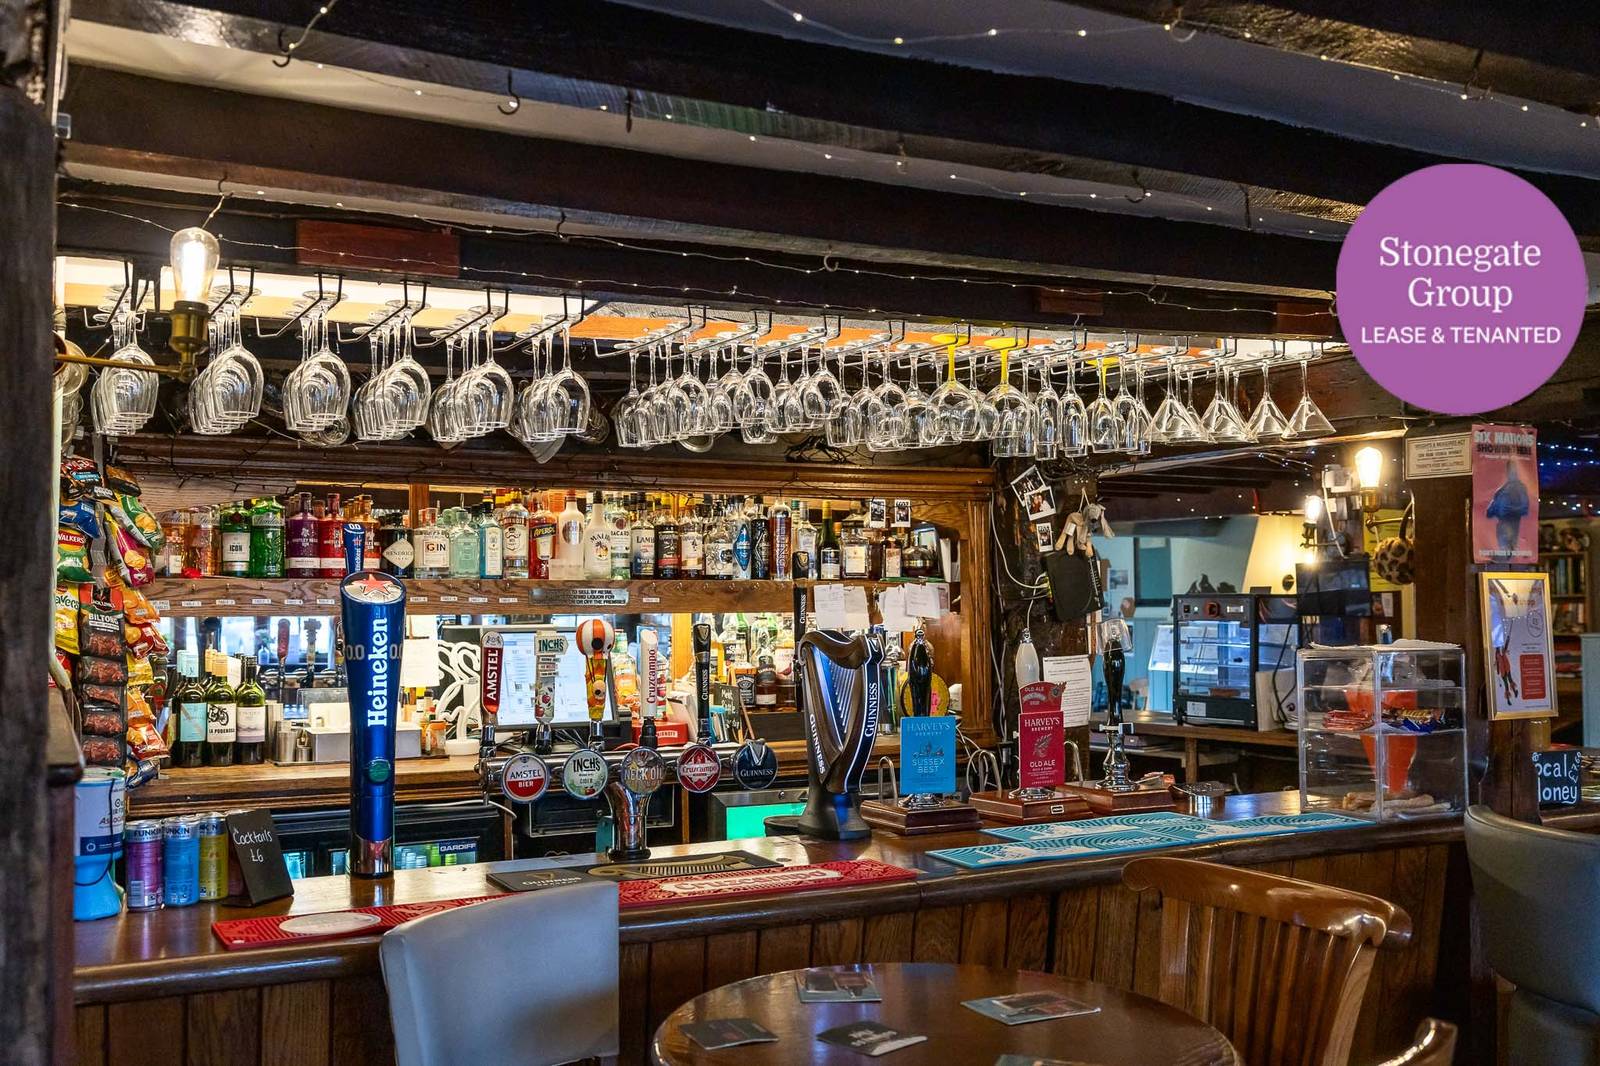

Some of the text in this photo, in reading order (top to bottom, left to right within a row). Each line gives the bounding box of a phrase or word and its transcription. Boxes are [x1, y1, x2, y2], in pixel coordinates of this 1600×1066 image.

[426, 543, 447, 553] GIN
[55, 596, 80, 610] avers
[89, 613, 119, 625] BILTONG
[539, 638, 564, 652] INCH'S
[367, 618, 388, 727] Heineken
[486, 649, 499, 701] AMSTEL
[646, 649, 656, 704] Cruzcampo
[701, 669, 709, 701] GUINNESS
[865, 682, 878, 737] GUINNESS
[1024, 717, 1060, 727] HARVEY'S
[809, 713, 826, 774] GUINNESS
[573, 757, 601, 772] INCH'S
[912, 758, 945, 766] SUSSEX
[918, 765, 940, 773] BEST
[1029, 759, 1056, 768] OLD ALE
[1535, 754, 1567, 778] ocal
[510, 769, 542, 779] AMSTEL
[624, 766, 663, 781] NECK OIL
[682, 765, 717, 774] Cruzcampo
[740, 769, 774, 777] GUINNESS
[1538, 777, 1578, 804] oney
[165, 827, 190, 835] UNKIN
[232, 827, 273, 845] Cocktails
